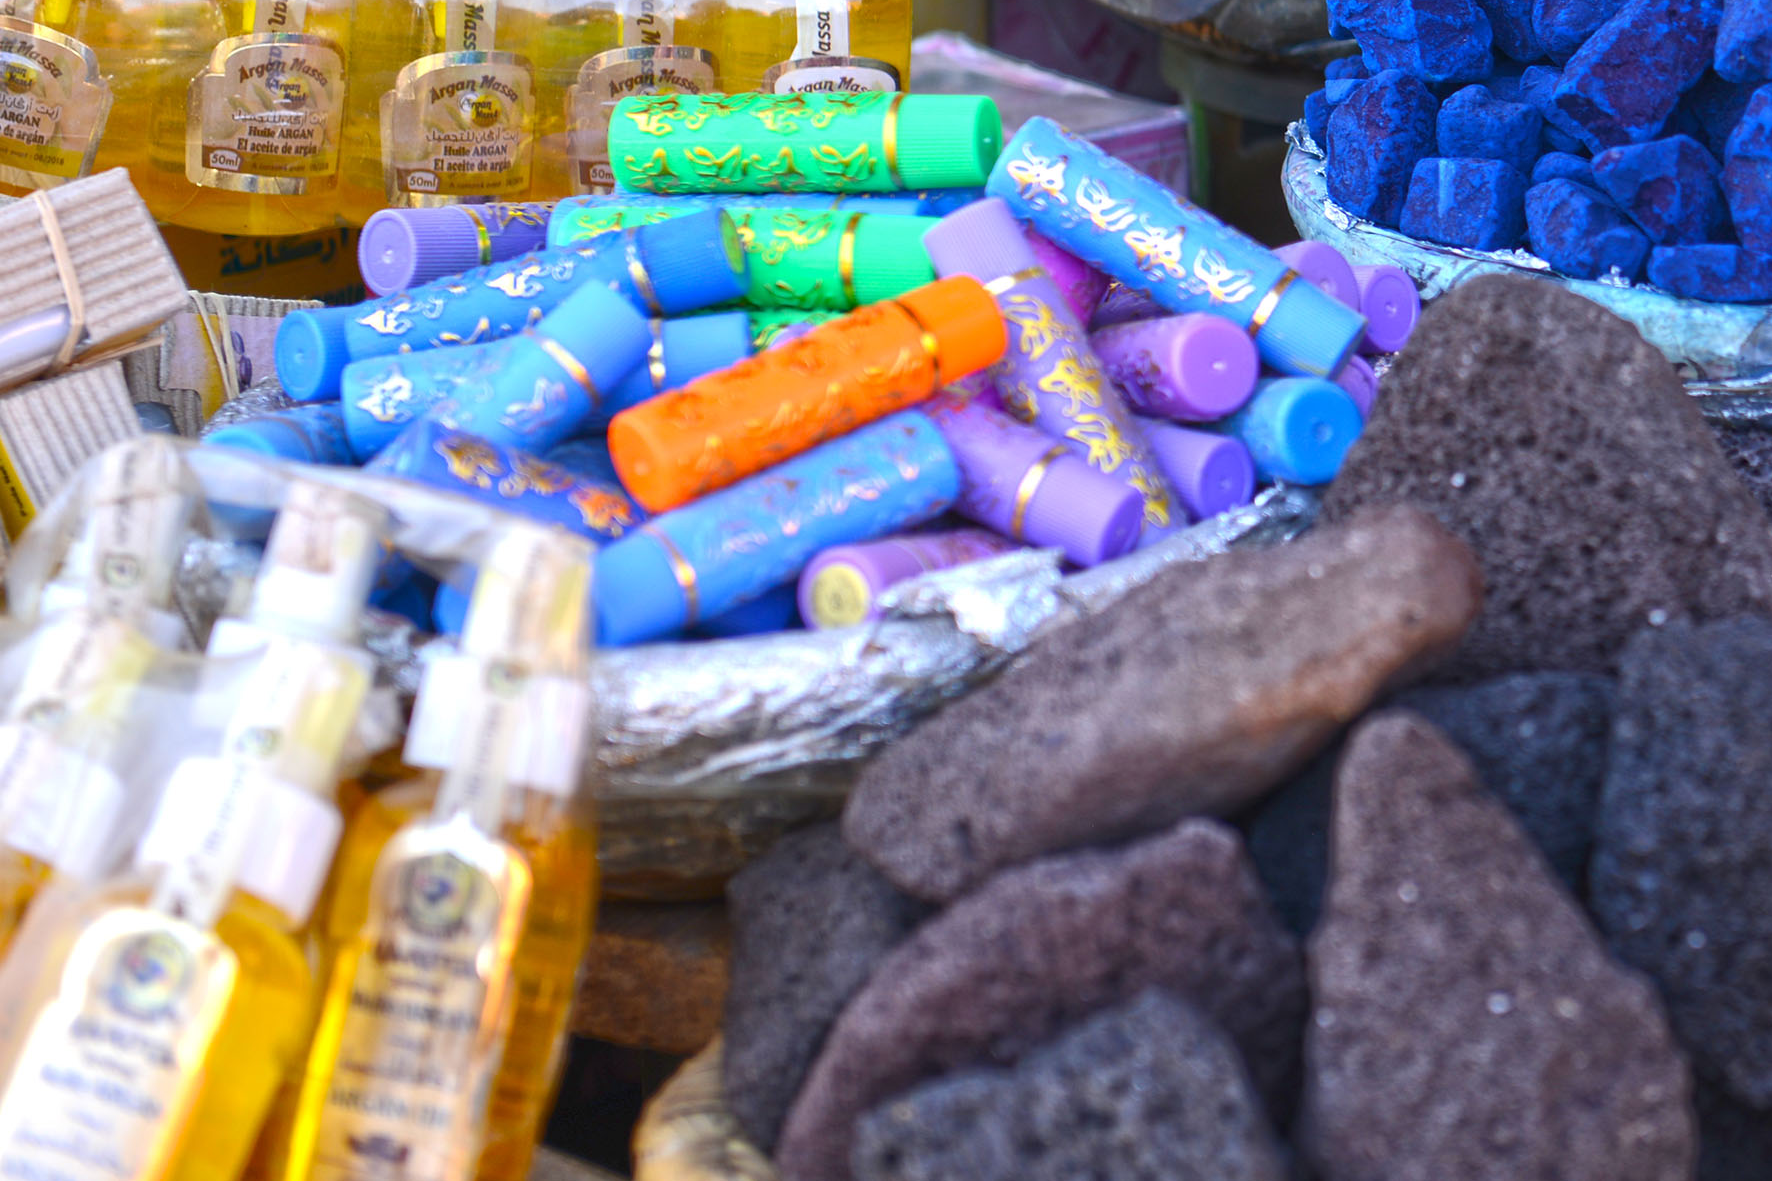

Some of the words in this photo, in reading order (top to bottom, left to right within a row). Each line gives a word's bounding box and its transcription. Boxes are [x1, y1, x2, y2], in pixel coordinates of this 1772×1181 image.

[463, 1, 485, 51] Mass
[16, 40, 63, 80] Massa
[290, 57, 329, 87] Massa
[429, 79, 476, 105] Argan
[479, 74, 519, 103] Massa
[608, 72, 655, 98] Argan
[658, 68, 700, 95] Massa
[1, 110, 41, 129] ARGAN
[277, 128, 315, 140] ARGAN
[237, 138, 248, 151] El
[250, 141, 279, 154] aceite
[281, 143, 293, 155] de
[443, 144, 471, 157] Huile
[472, 145, 508, 157] ARGAN
[210, 153, 239, 168] 50ml
[433, 158, 446, 172] El
[447, 159, 475, 172] aceite
[477, 160, 488, 172] de
[408, 175, 438, 189] 50ml
[590, 167, 614, 180] 50m
